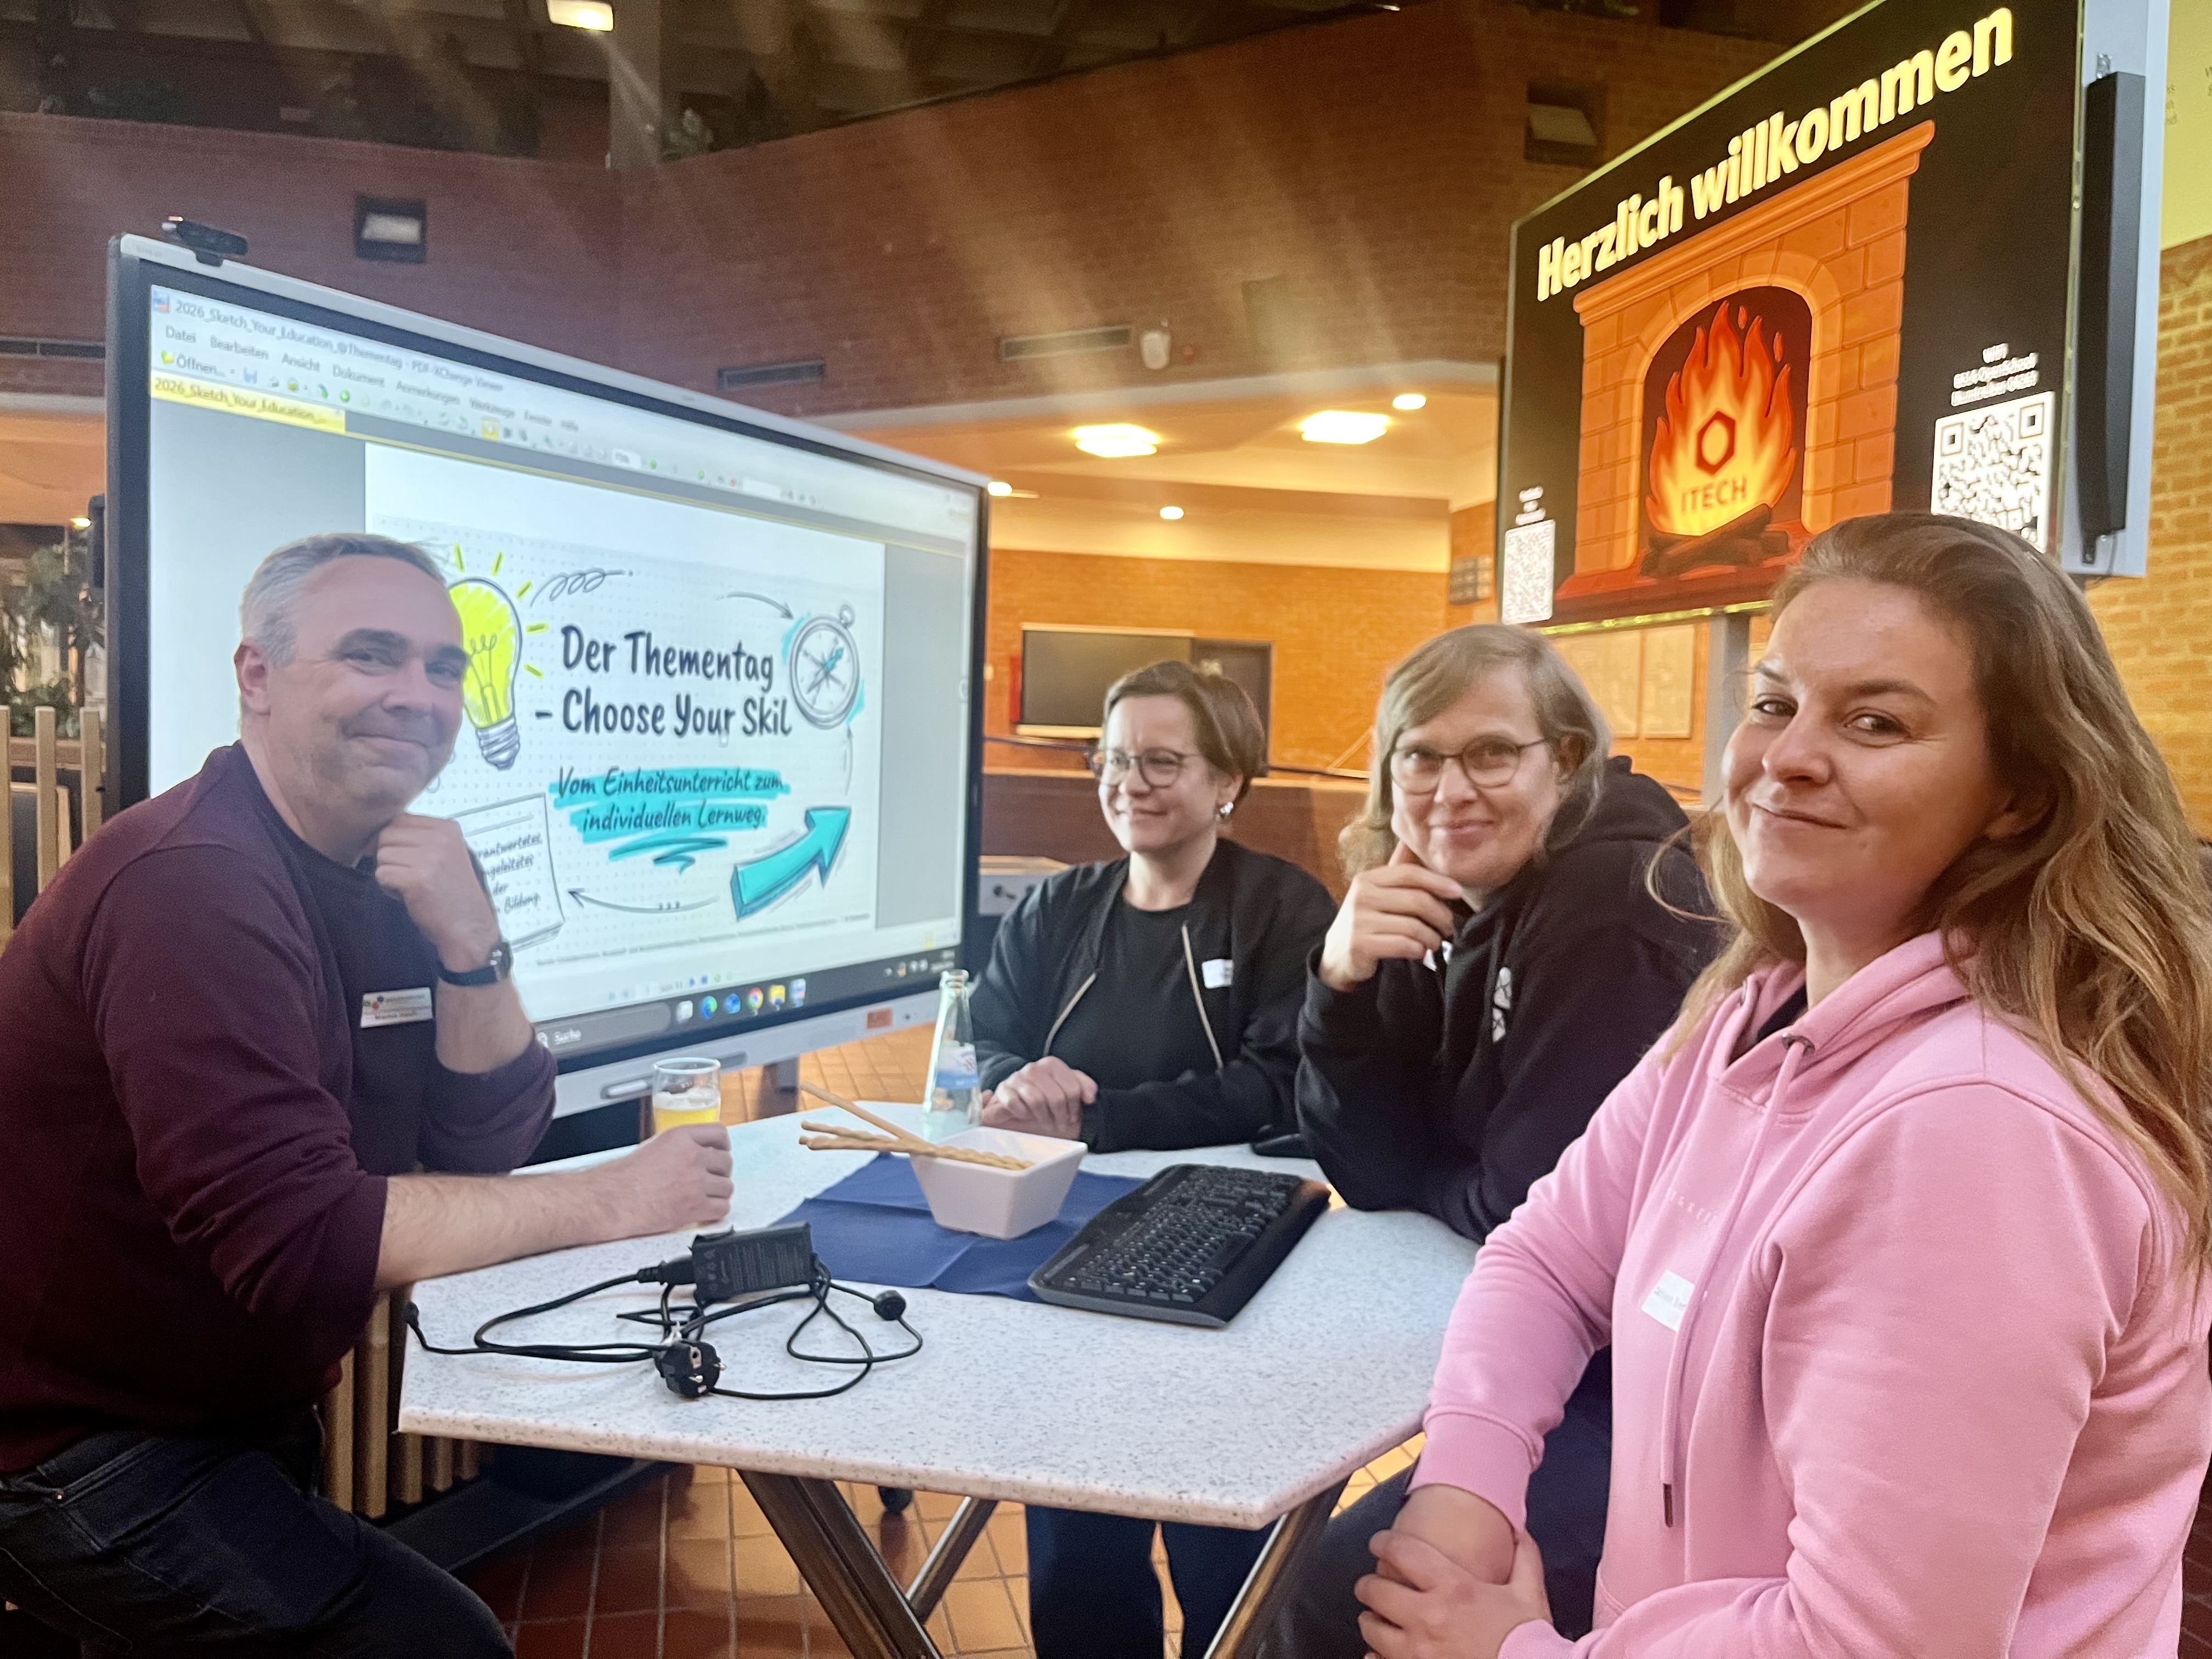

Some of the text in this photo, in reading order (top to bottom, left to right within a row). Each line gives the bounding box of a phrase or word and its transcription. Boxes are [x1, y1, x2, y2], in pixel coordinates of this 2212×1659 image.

[1538, 7, 2013, 302] Herzlich willkommen
[166, 325, 196, 343] Datei
[210, 335, 269, 360] Bearbeiten
[1681, 475, 1748, 515] ITECH
[561, 625, 774, 693] Der Thementag
[562, 686, 665, 735] Choose
[674, 692, 736, 738] Your
[742, 695, 793, 736] Skil
[558, 765, 783, 799] Vom Einheitsunterricht zum
[583, 802, 691, 833] individuellen
